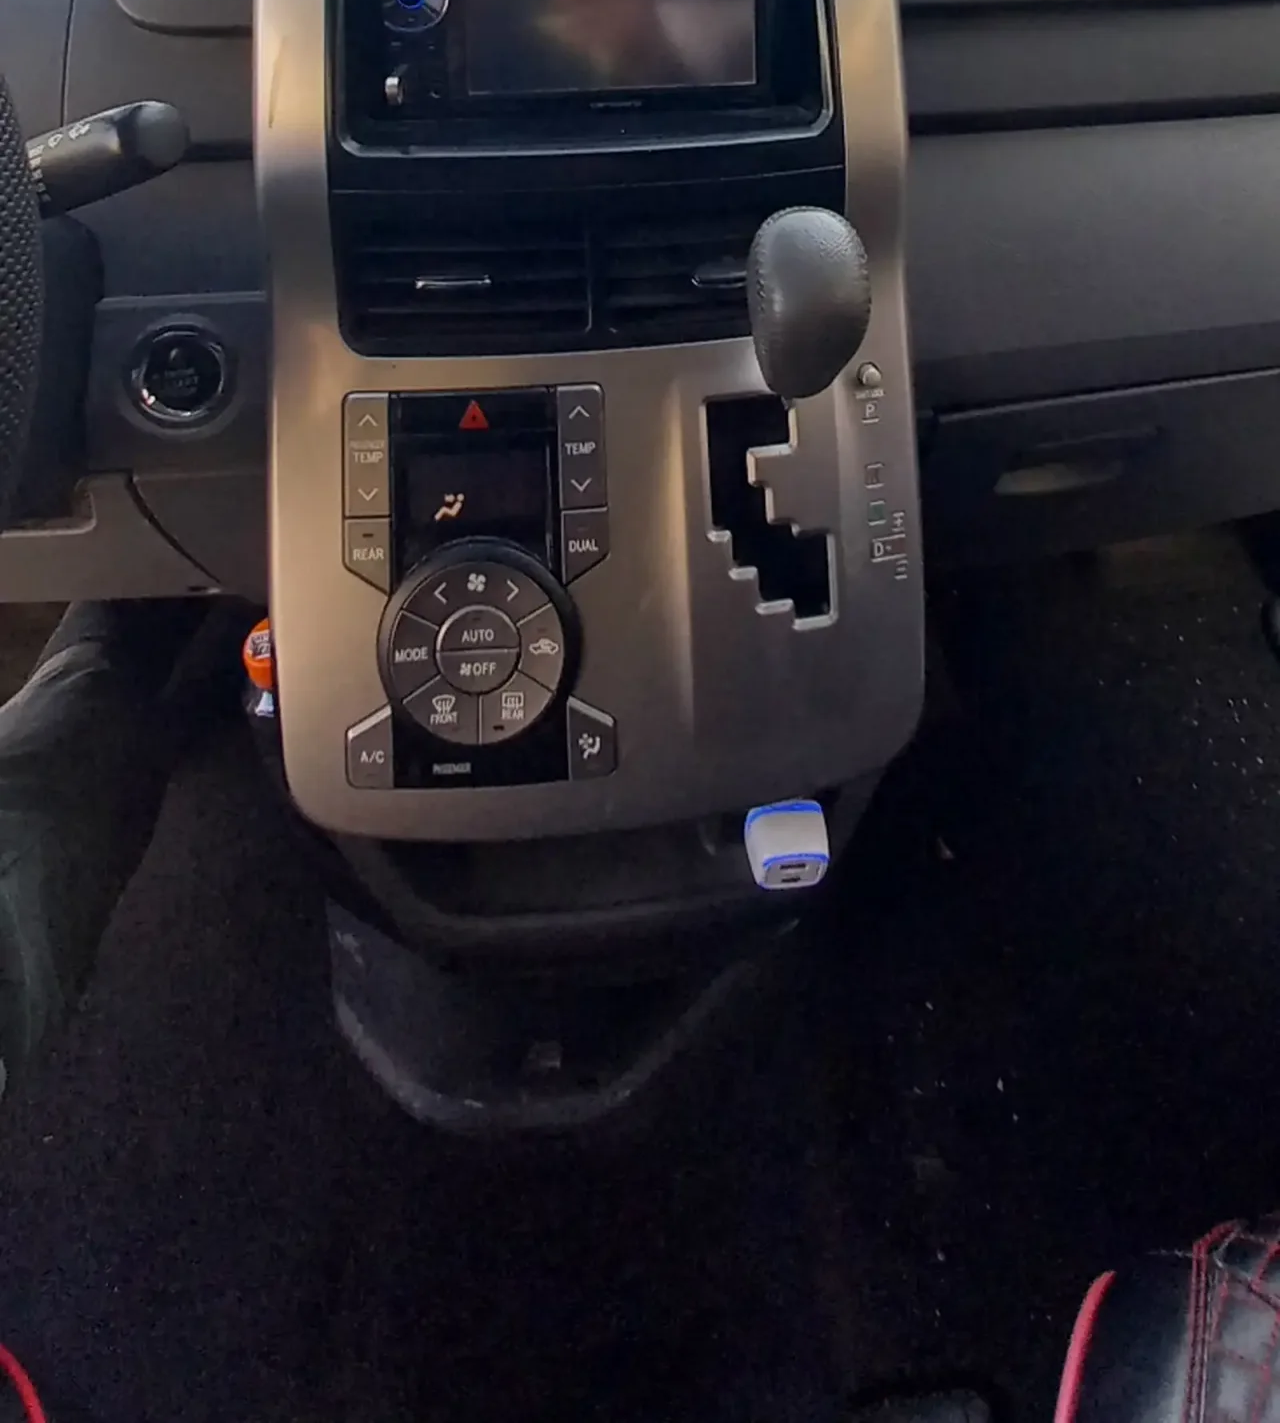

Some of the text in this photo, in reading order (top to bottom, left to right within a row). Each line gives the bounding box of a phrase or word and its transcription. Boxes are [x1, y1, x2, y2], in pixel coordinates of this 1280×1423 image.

[565, 441, 597, 455] TEMP
[568, 538, 599, 553] DUAL
[352, 547, 385, 561] REAR
[461, 628, 495, 643] AUTO
[394, 646, 429, 664] MODE
[472, 661, 497, 677] OFF
[360, 749, 386, 764] A/C
